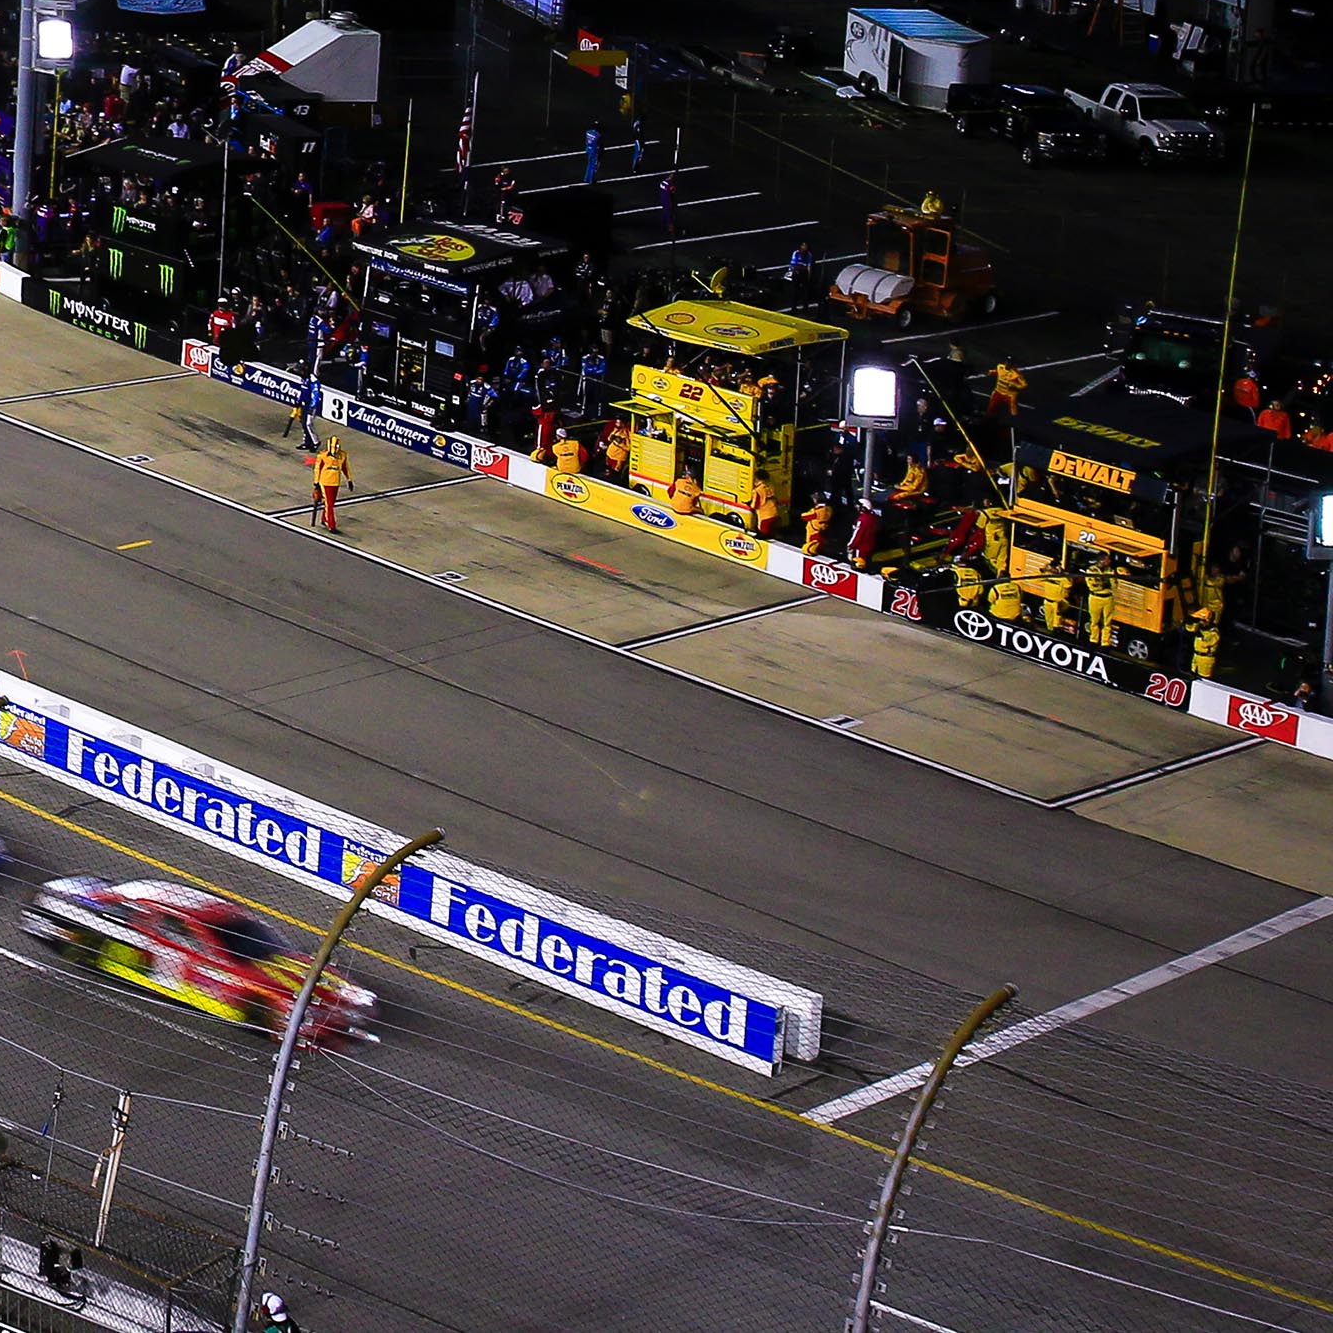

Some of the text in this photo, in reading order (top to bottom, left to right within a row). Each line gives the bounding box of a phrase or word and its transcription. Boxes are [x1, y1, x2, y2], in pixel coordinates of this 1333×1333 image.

[293, 104, 310, 116] 43
[301, 141, 316, 154] 11
[63, 296, 132, 336] MONSTER
[72, 319, 120, 341] ENERGY
[245, 369, 302, 399] Auto-Own
[679, 383, 704, 401] 22
[263, 388, 302, 406] INSURAN
[331, 398, 344, 420] 3
[348, 403, 430, 445] Auto-Owners
[367, 425, 413, 447] INSURANCE
[556, 481, 585, 496] PENNZOIL
[638, 507, 668, 527] Ford
[724, 538, 757, 553] PENNZOIL
[813, 566, 835, 582] AAA
[996, 623, 1108, 681] TOYOTA
[1145, 673, 1187, 707] 20
[4, 702, 46, 726] ederated
[1241, 704, 1271, 726] AAA
[66, 728, 321, 873] Federated
[430, 874, 748, 1047] Federated
